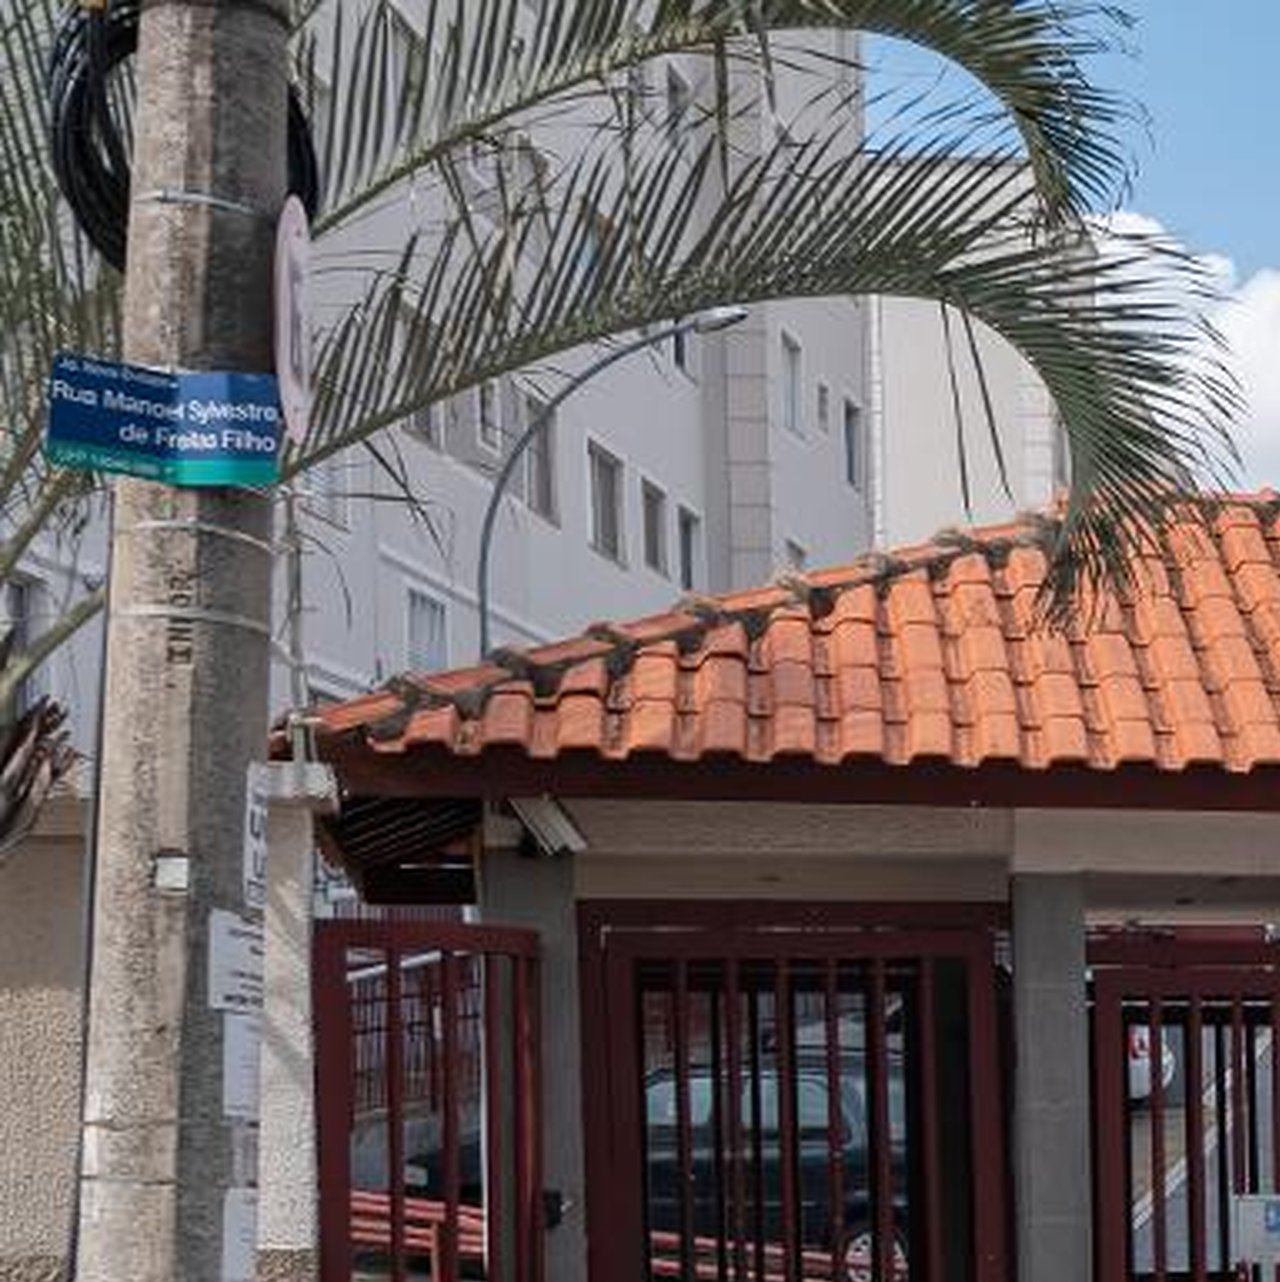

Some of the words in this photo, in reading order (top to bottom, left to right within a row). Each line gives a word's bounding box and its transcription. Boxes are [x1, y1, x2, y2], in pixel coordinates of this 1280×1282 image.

[52, 380, 97, 405] Rua
[119, 423, 148, 443] de
[221, 430, 276, 452] Filho
